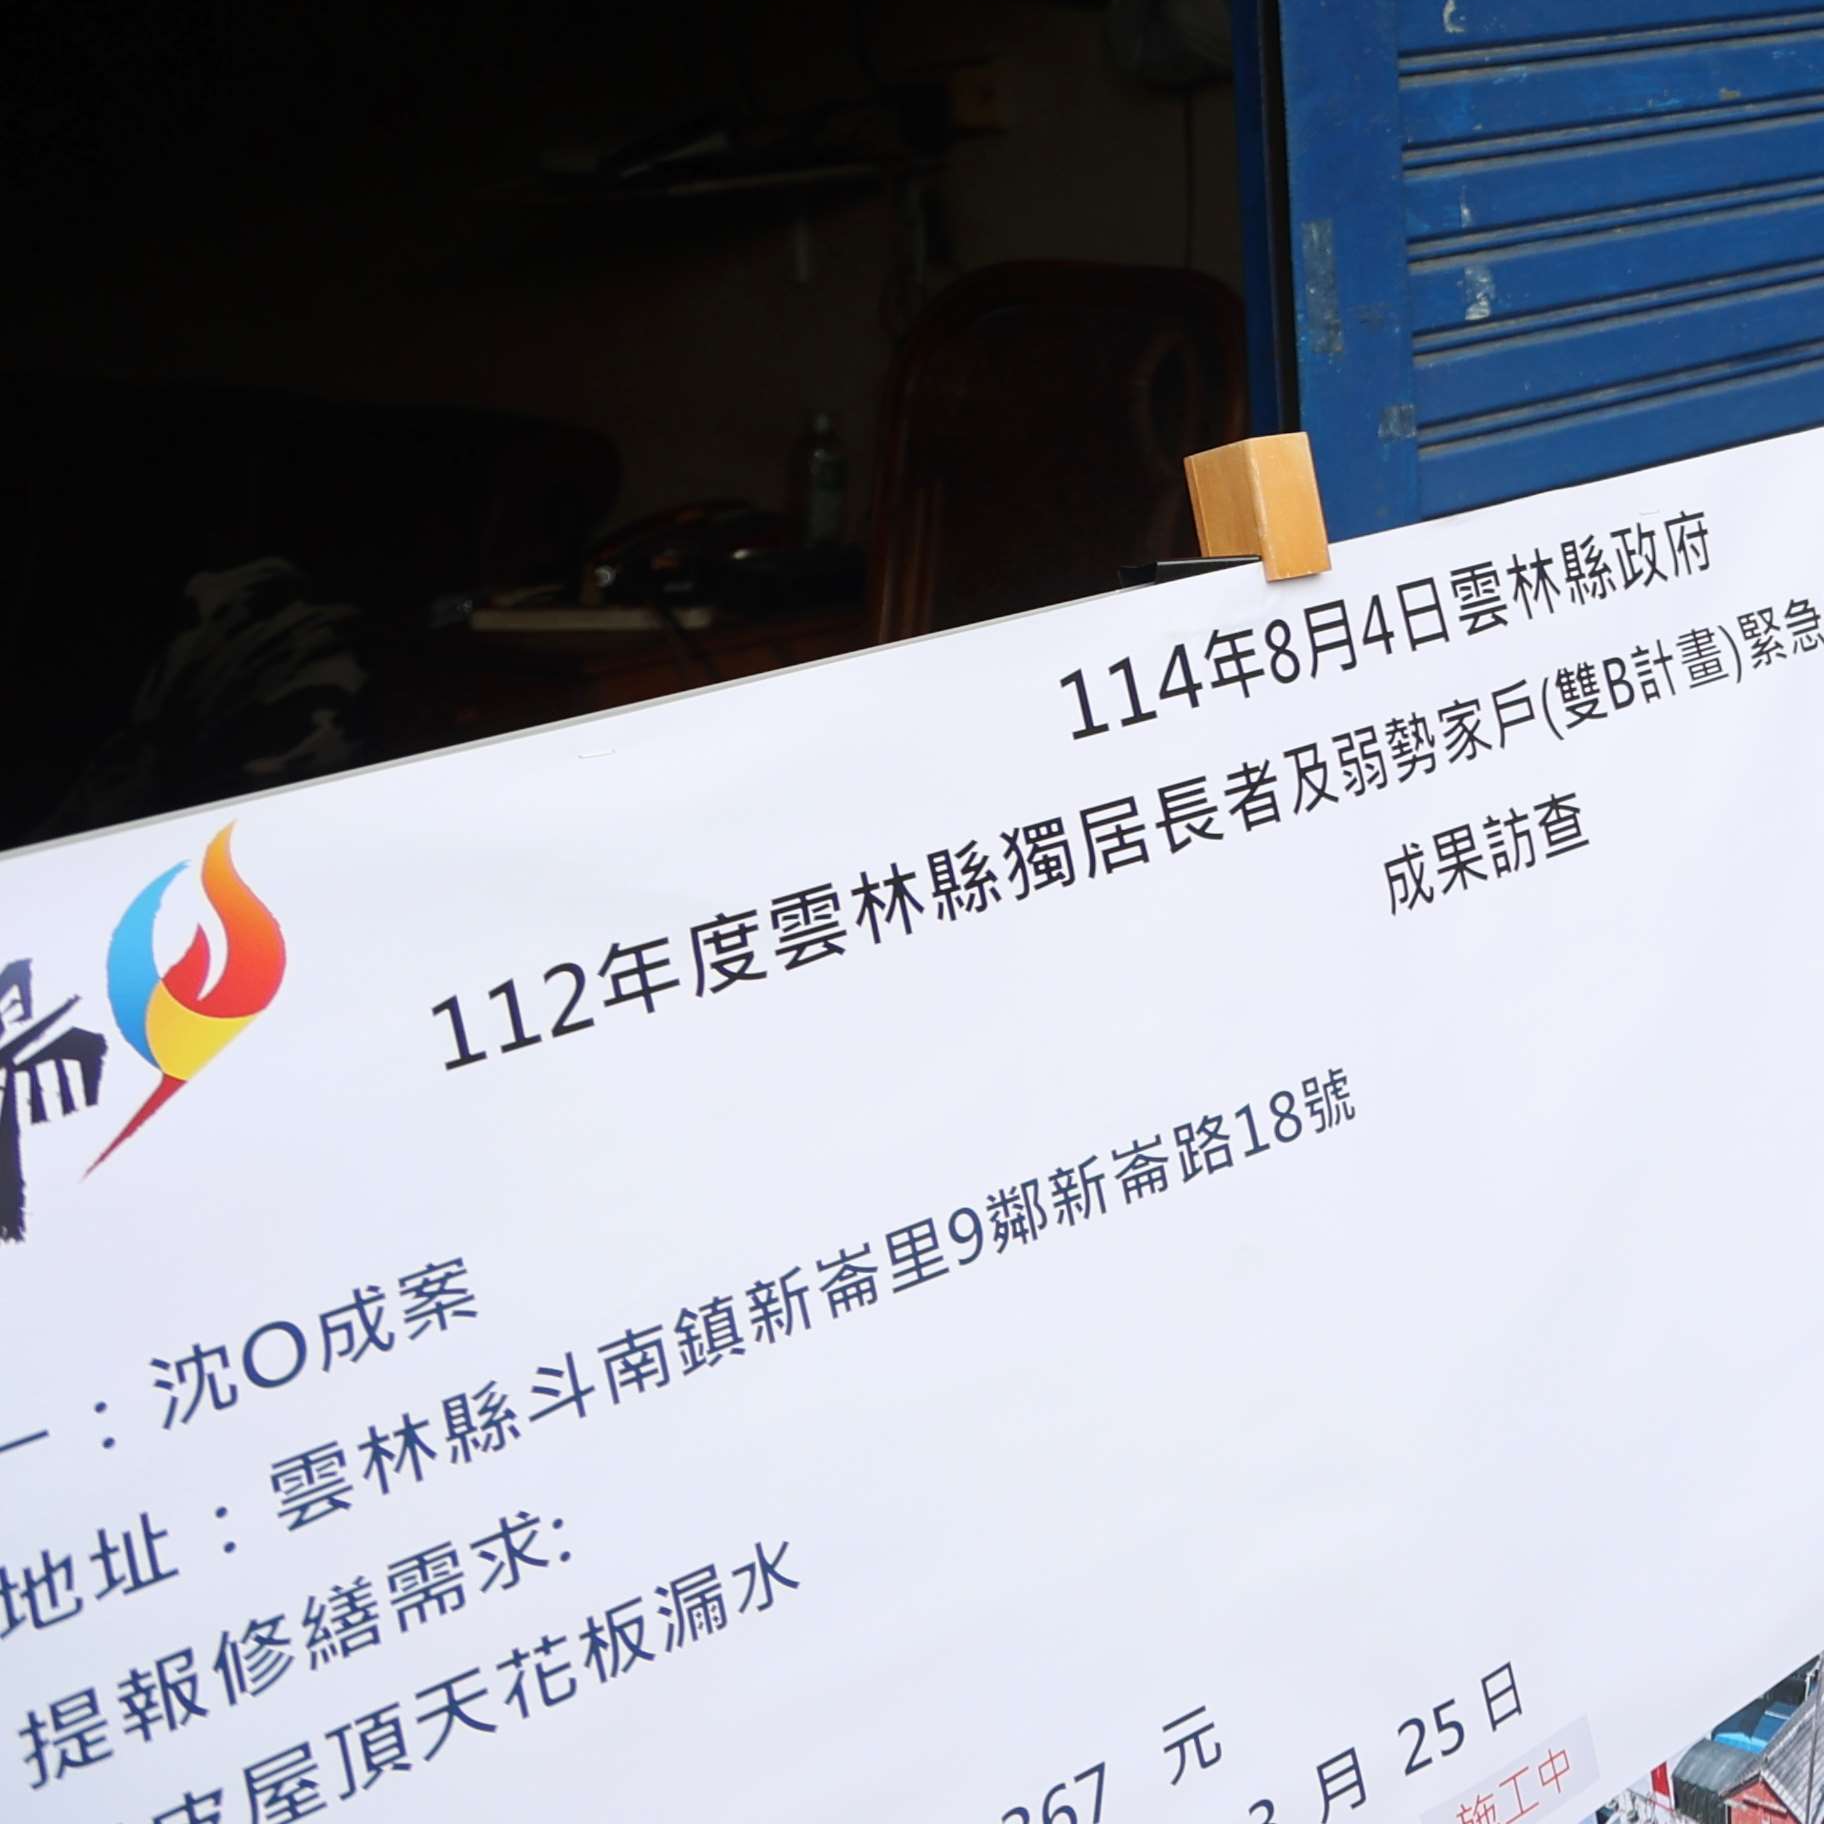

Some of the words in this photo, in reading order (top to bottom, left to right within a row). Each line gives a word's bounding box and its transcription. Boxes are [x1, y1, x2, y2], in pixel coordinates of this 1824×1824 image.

[1060, 511, 1709, 740] 114年8月4日雲林縣政府
[1384, 793, 1589, 915] 成果訪查
